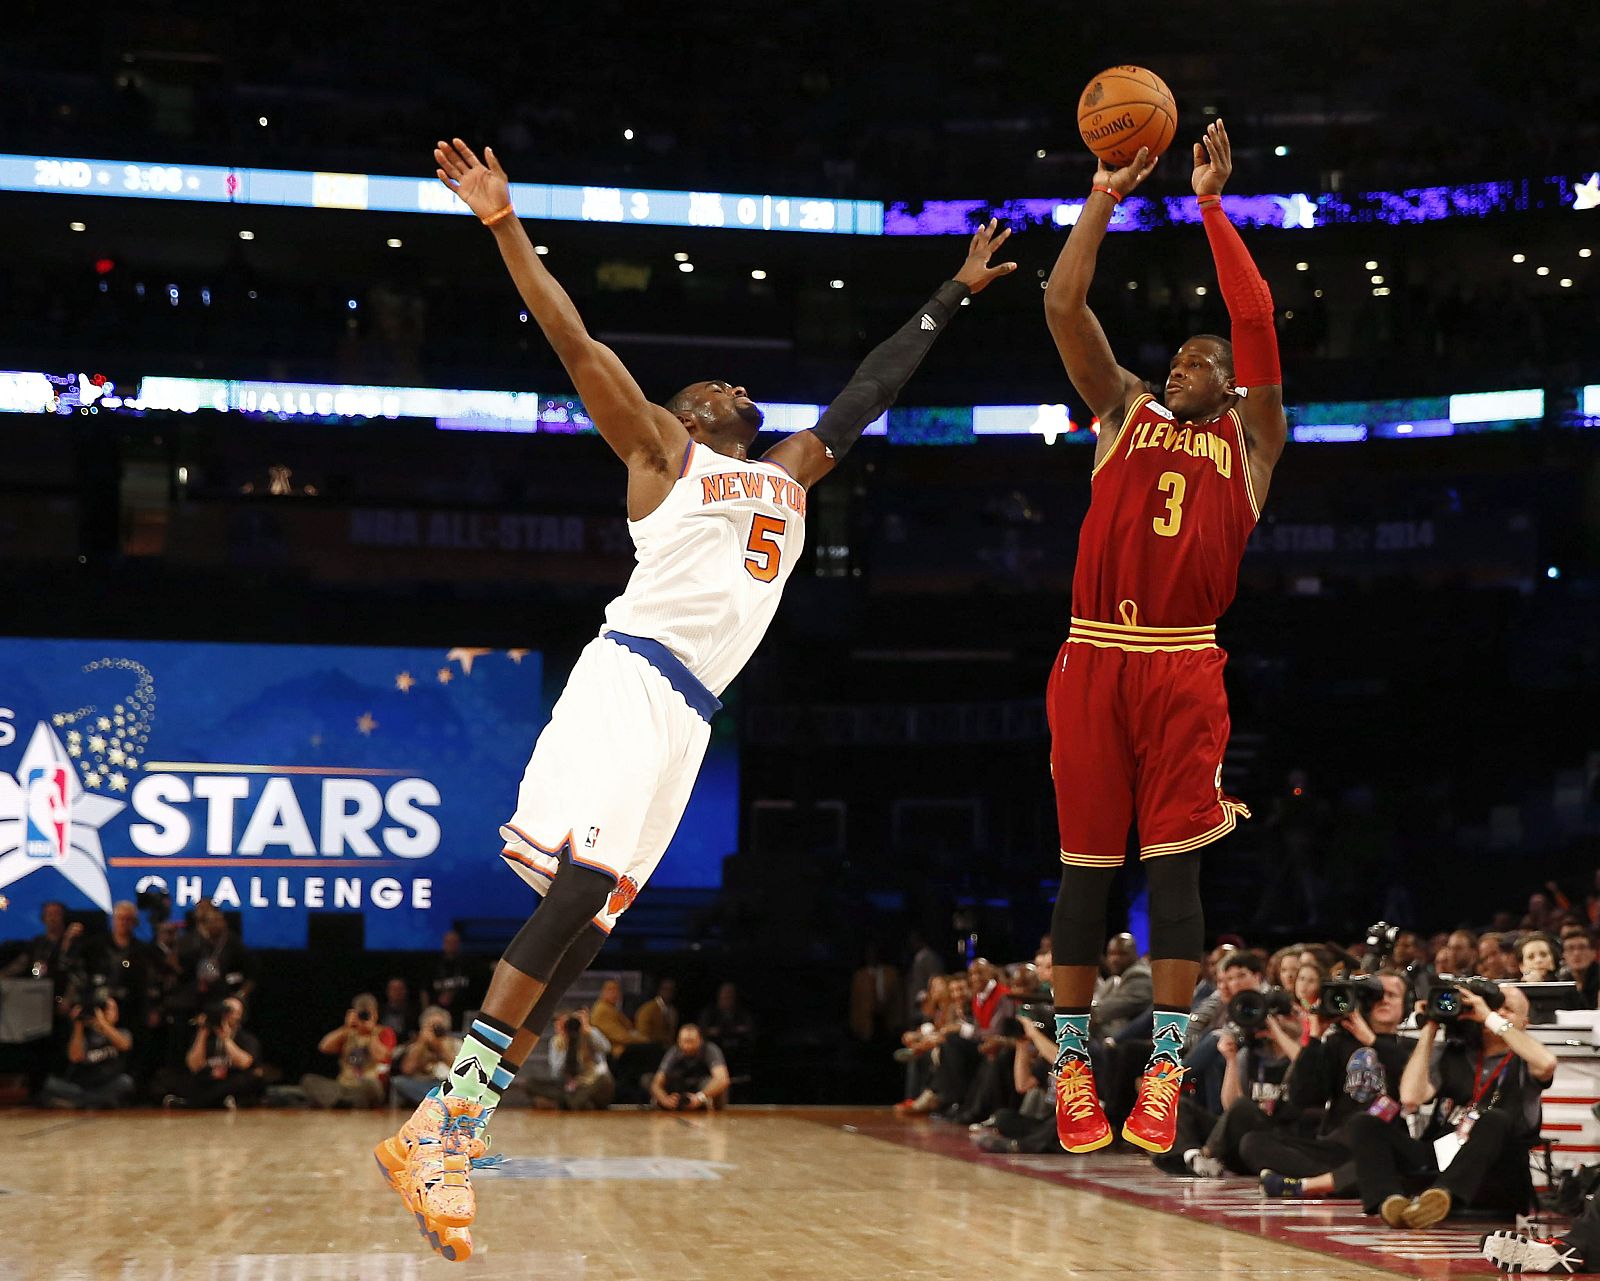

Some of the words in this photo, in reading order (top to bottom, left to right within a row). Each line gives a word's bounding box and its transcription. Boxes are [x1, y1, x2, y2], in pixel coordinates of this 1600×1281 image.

[1125, 421, 1232, 479] CLEVELAND
[701, 471, 765, 505] NEW
[1152, 471, 1186, 537] 3
[351, 510, 417, 545] NBA
[430, 511, 584, 551] ALL-STAR
[743, 512, 787, 584] 5
[1375, 520, 1435, 549] 2014
[130, 774, 441, 859] STARS
[136, 875, 434, 909] CHALLENGE
